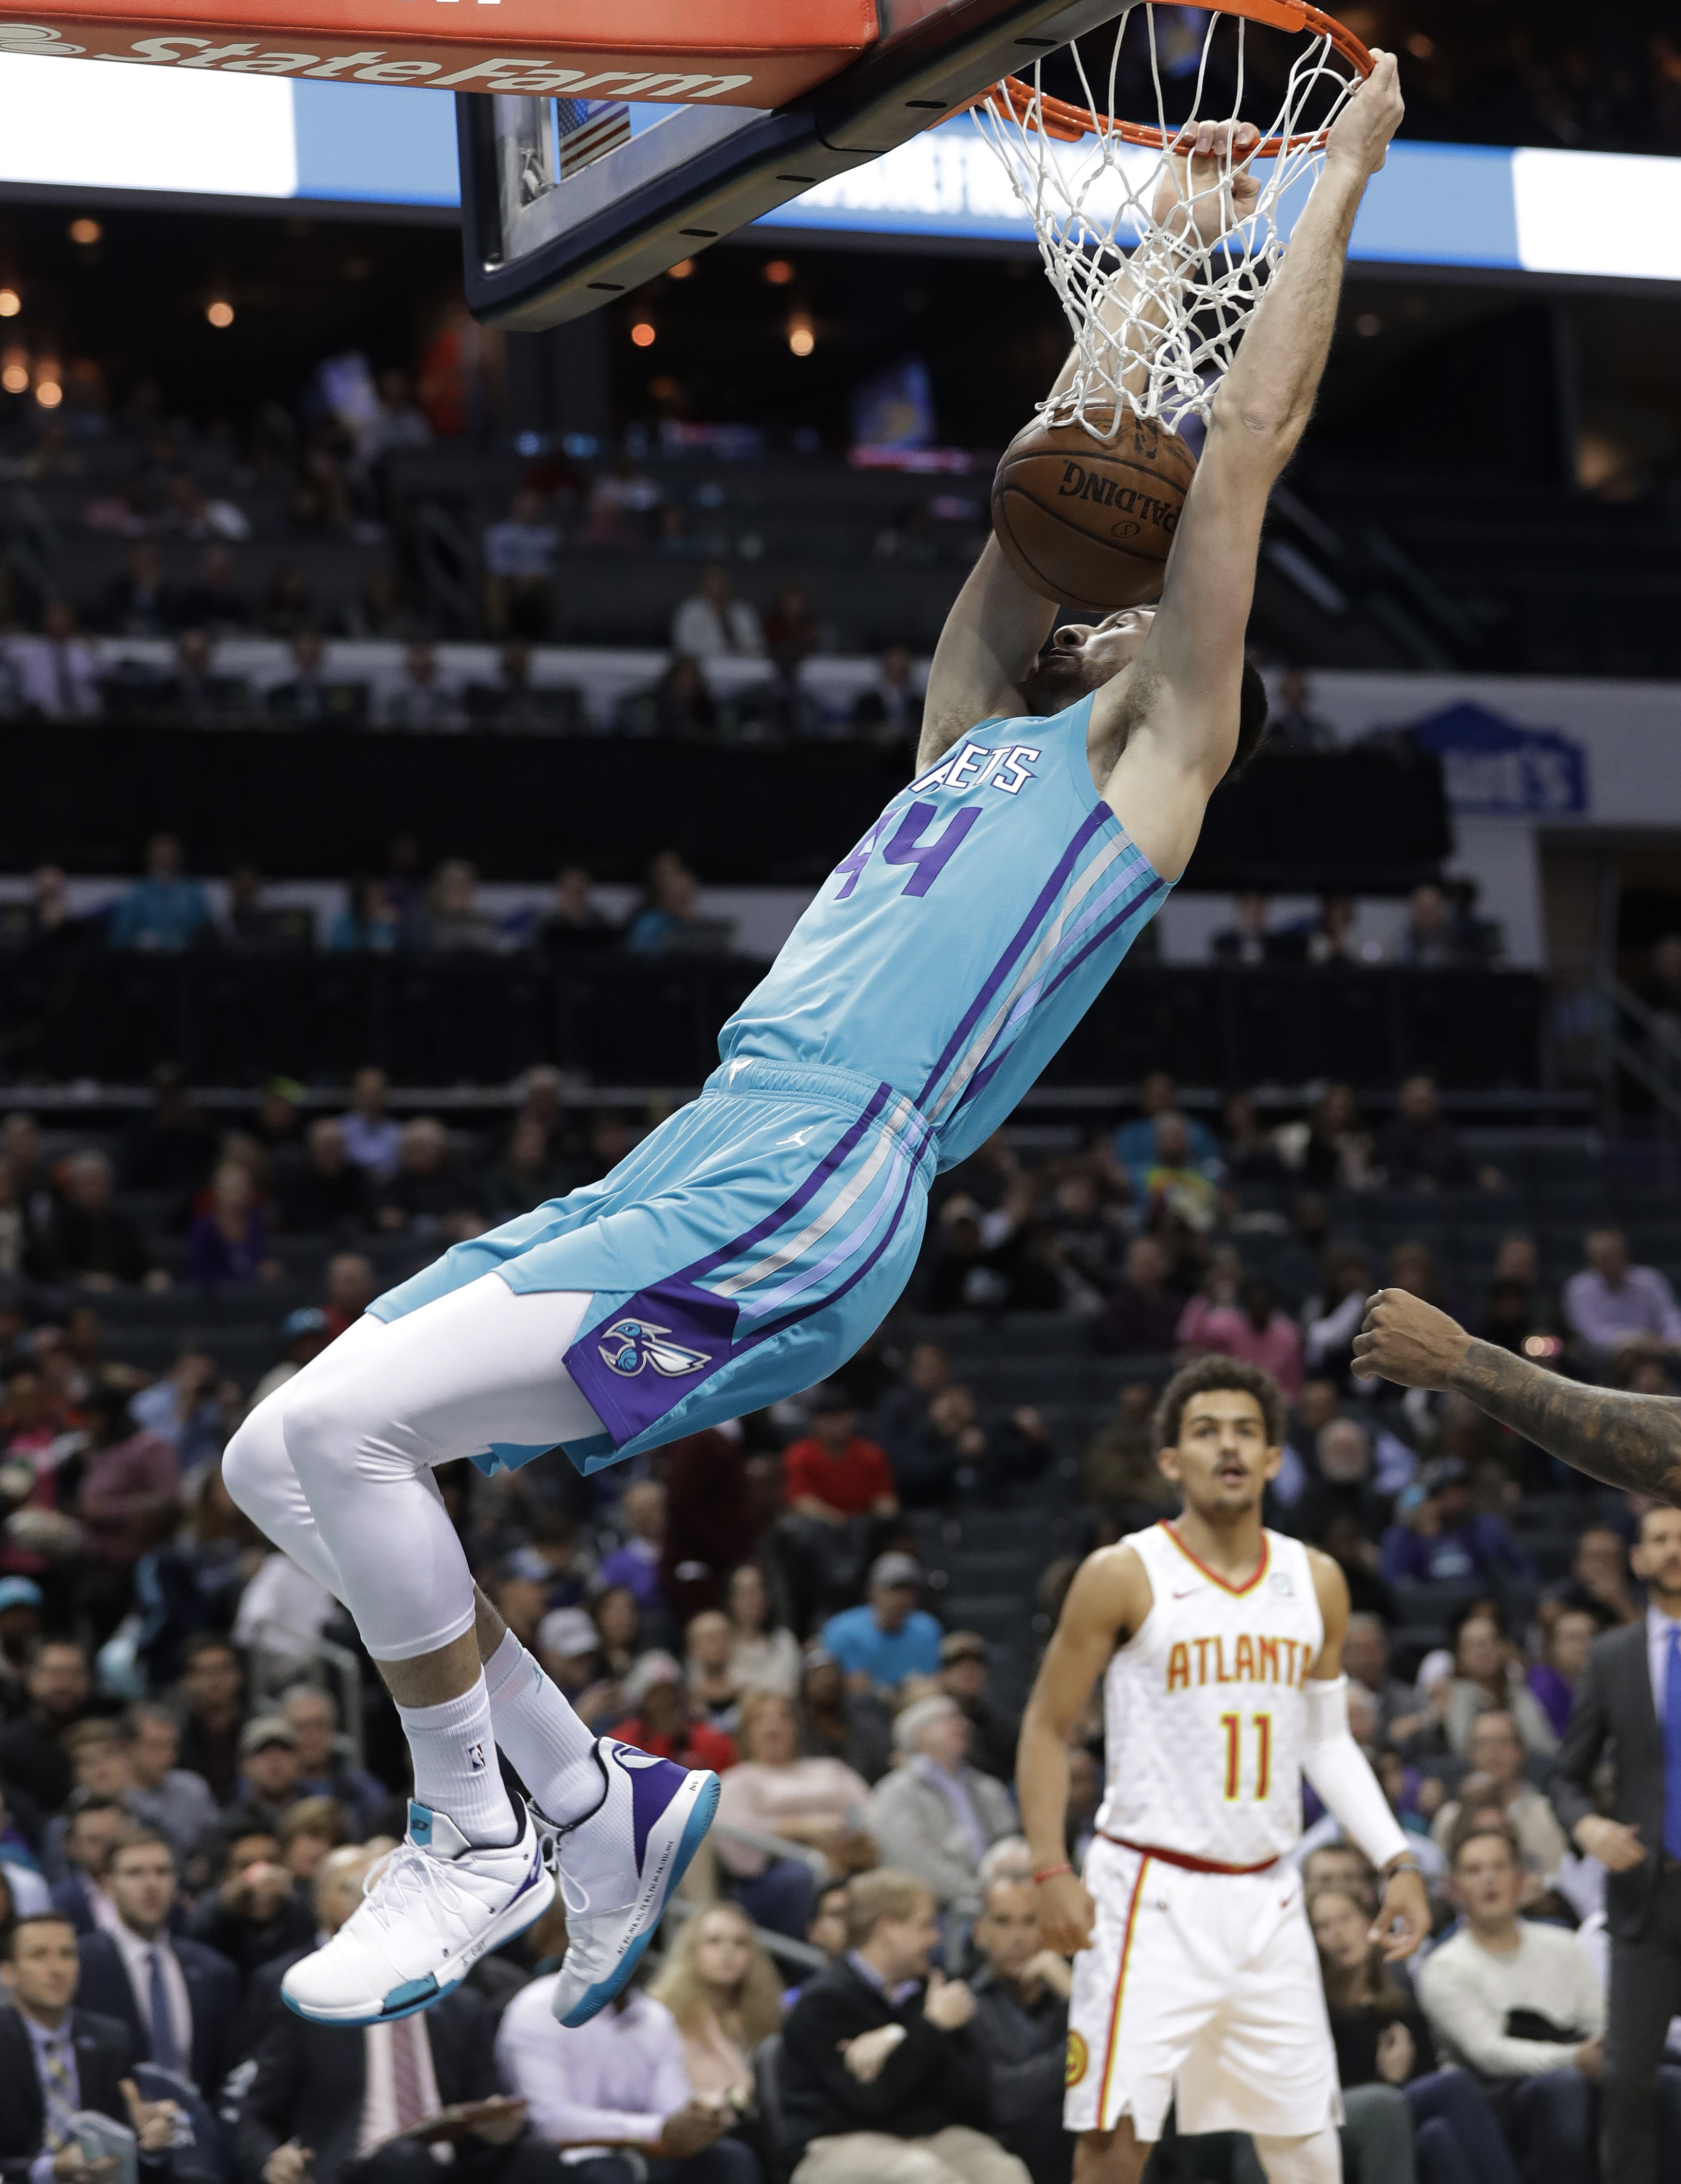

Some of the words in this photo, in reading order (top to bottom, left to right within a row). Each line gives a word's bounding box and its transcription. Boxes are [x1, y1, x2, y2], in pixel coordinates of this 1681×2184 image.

[93, 37, 443, 82] State
[423, 58, 753, 98] Farm
[1058, 459, 1183, 535] PALDING
[834, 801, 984, 900] 44
[1219, 1710, 1272, 1802] 11
